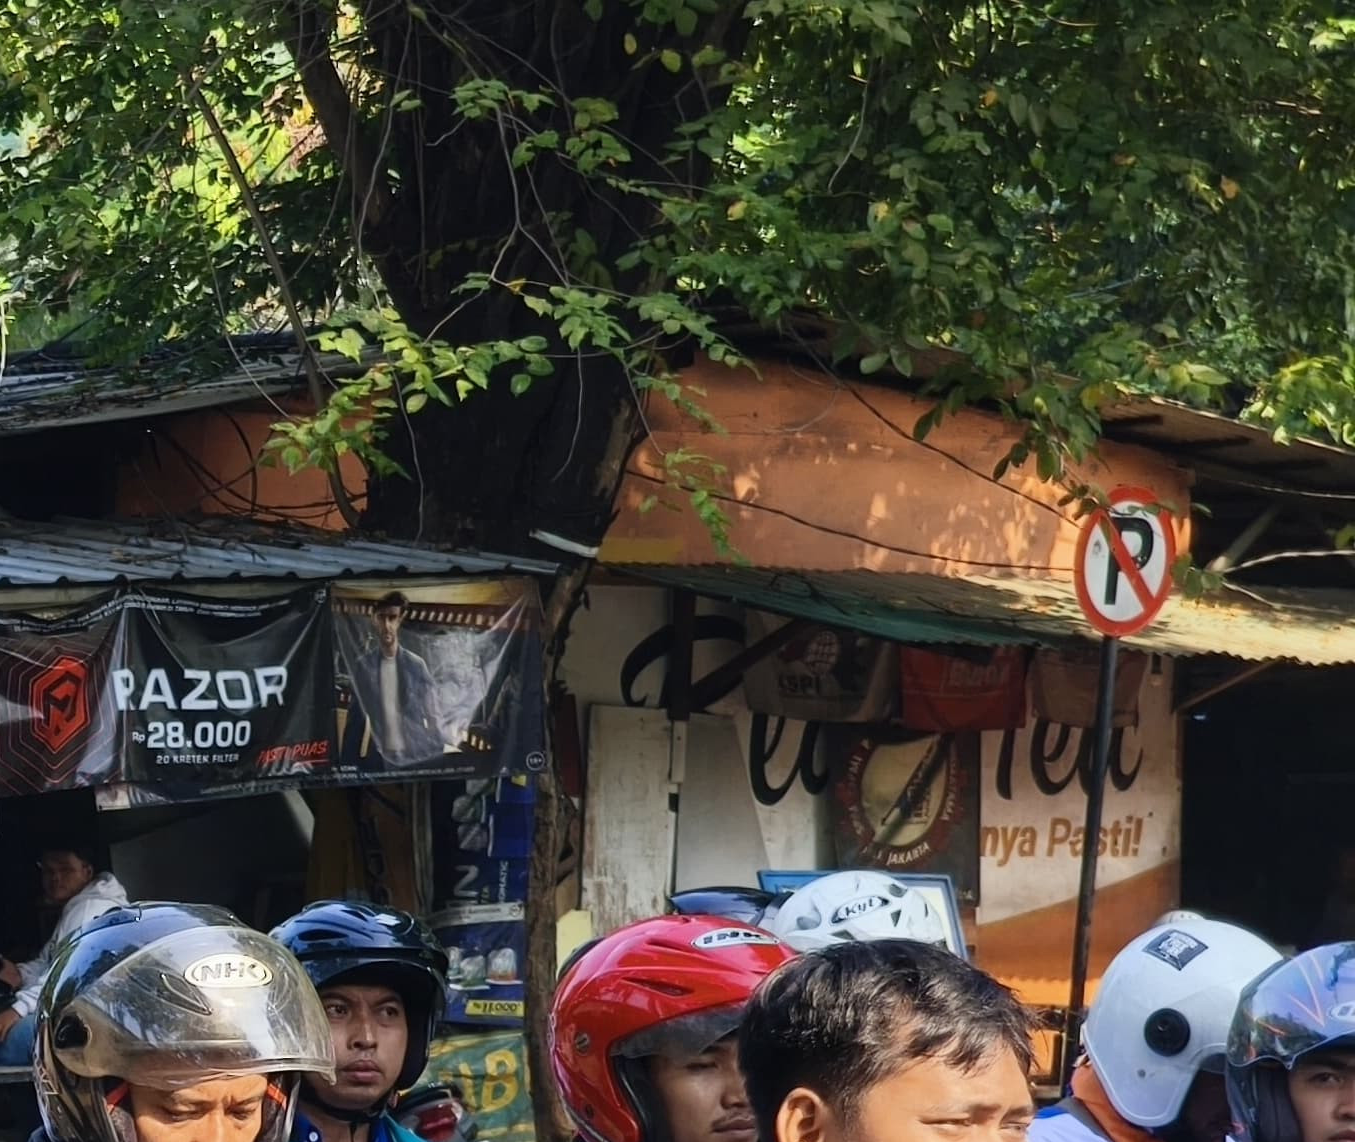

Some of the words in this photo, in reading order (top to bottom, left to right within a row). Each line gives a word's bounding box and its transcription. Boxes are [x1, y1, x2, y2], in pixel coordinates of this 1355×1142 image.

[111, 665, 289, 712] RAZOR
[131, 731, 146, 744] Rp
[146, 720, 252, 750] 28.000
[155, 754, 170, 765] 20
[172, 753, 210, 765] KRETEK
[211, 752, 240, 764] FILTER
[291, 740, 330, 759] PUAS
[1046, 816, 1144, 857] Pasti!
[885, 842, 933, 867] JAKARTA
